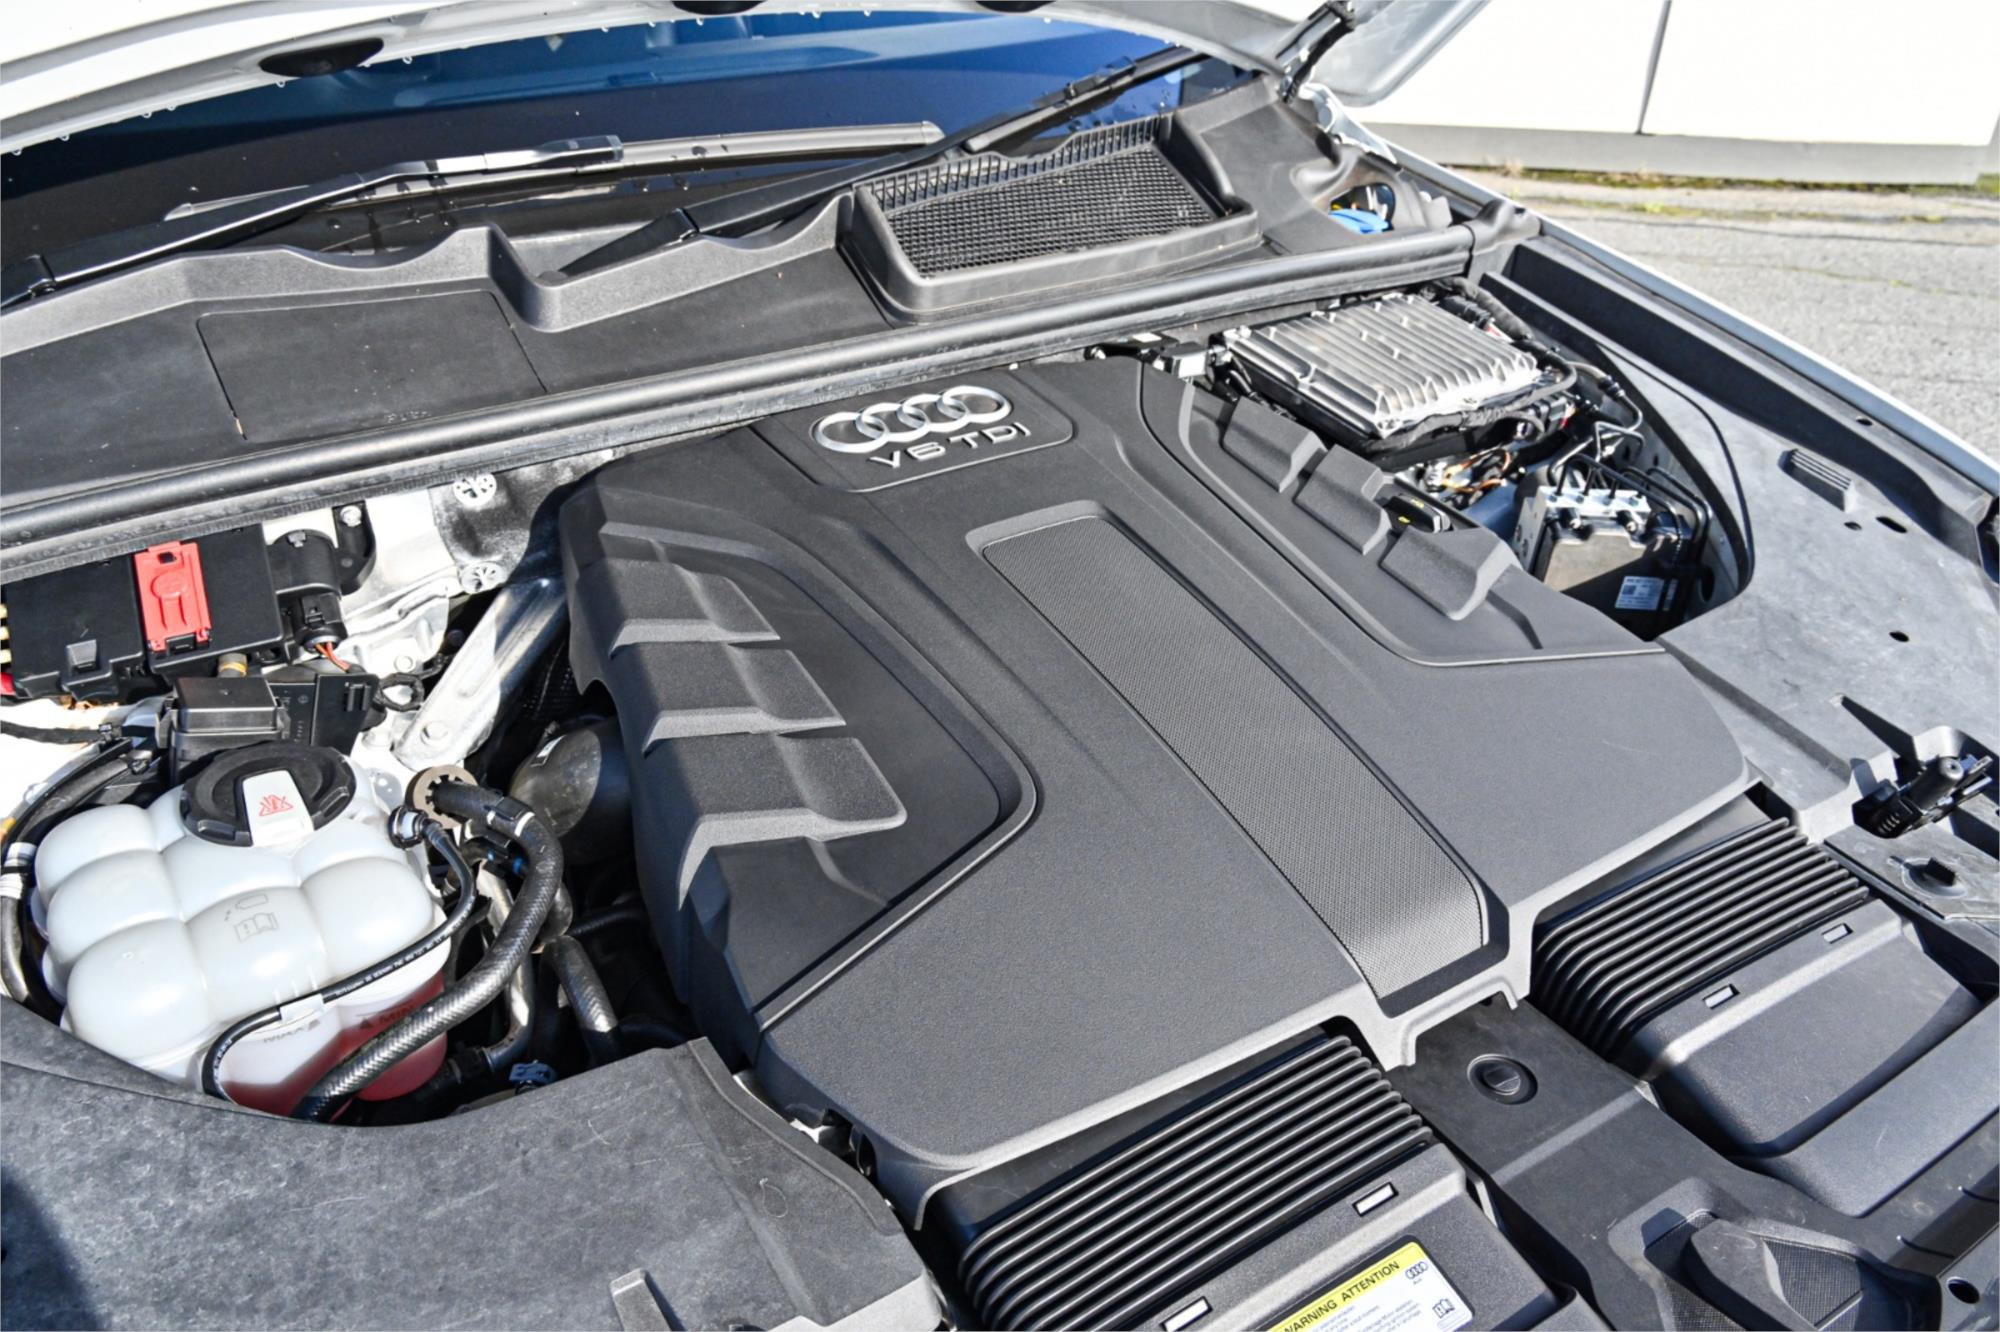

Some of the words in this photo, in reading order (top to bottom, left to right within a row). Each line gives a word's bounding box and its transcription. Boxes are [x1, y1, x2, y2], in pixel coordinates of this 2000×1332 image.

[870, 442, 946, 468] V6
[949, 422, 1030, 448] TDI
[1341, 1261, 1400, 1301] ATTENTION
